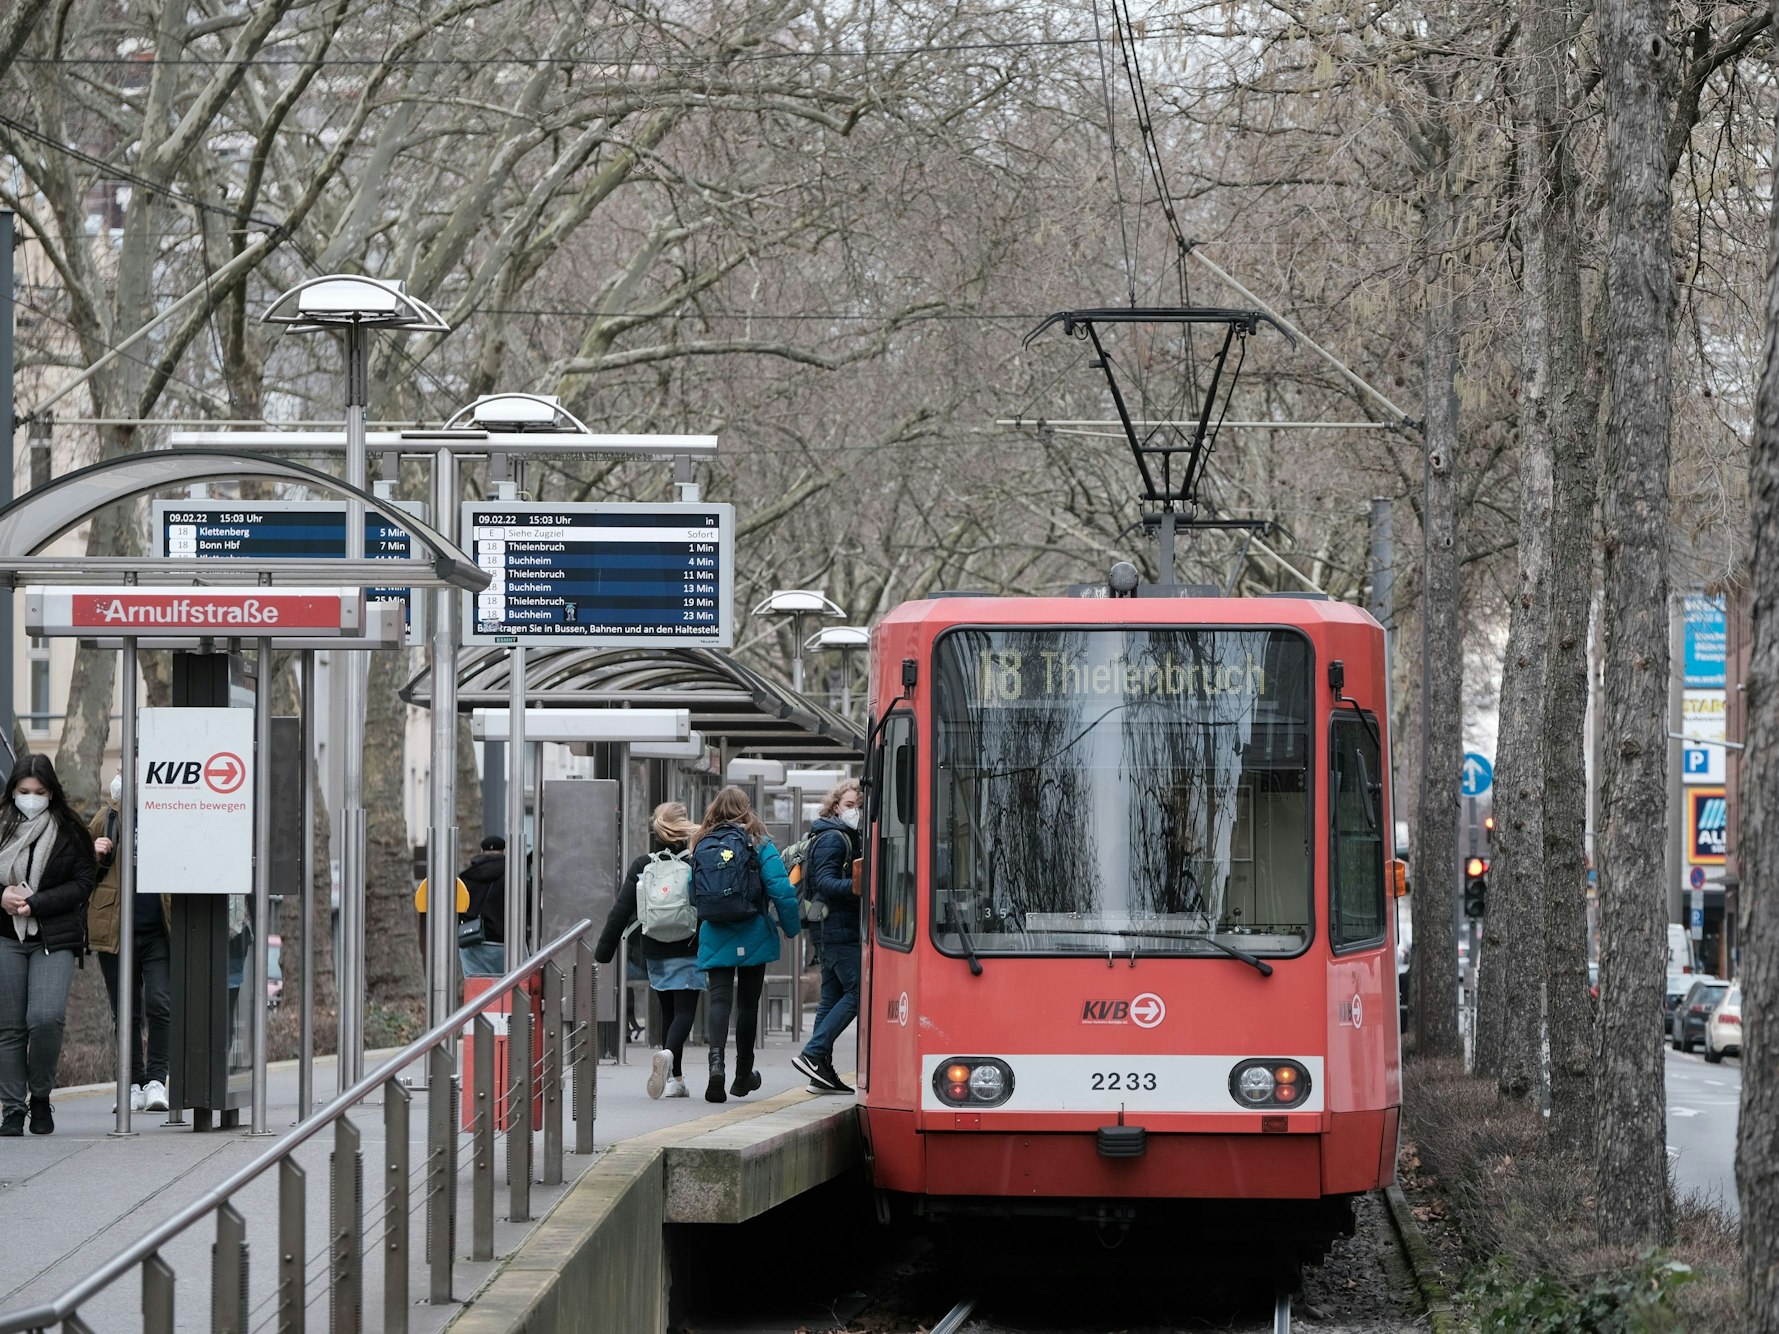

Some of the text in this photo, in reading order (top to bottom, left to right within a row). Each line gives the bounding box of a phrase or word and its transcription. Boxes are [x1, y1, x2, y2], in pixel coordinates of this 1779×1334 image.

[169, 513, 263, 523] 09.02.22 15:03 Uhr
[478, 515, 714, 525] 09.02.22 15:03 Uhr in
[178, 527, 405, 538] 18 Klettenberg 5 Min
[508, 530, 532, 538] Siehe
[534, 530, 564, 539] Zugziel
[687, 530, 714, 539] Sofort
[178, 541, 405, 550] 18 Bonn Hbf 7 Min
[508, 542, 565, 551] Thielenbruch
[688, 544, 694, 552] 1
[696, 544, 714, 552] Min
[487, 556, 714, 566] 18 Buchheim 4 Min
[508, 570, 565, 578] Thielenbruch
[683, 571, 694, 579] 11
[696, 571, 714, 579] Min
[508, 583, 552, 592] Buchheim
[683, 584, 694, 593] 13
[696, 584, 714, 593] Min
[487, 597, 714, 607] 18 Thielenbruch 19 Min
[104, 599, 278, 623] Arnulfstraße
[508, 610, 552, 619] Buchheim
[683, 611, 694, 620] 23
[696, 611, 714, 620] Min
[500, 625, 527, 634] tragen
[529, 624, 542, 633] Sie
[544, 625, 553, 633] in
[555, 625, 587, 635] Bussen,
[590, 625, 622, 633] Bahnen
[624, 625, 642, 634] und
[643, 626, 653, 634] an
[656, 625, 673, 634] den
[980, 648, 1265, 700] 18 Thielenbruch
[1689, 750, 1704, 772] P
[146, 762, 201, 784] KVB
[144, 801, 246, 813] Menschen bewegen
[1083, 1001, 1129, 1020] KVB
[1091, 1072, 1157, 1091] 2233
